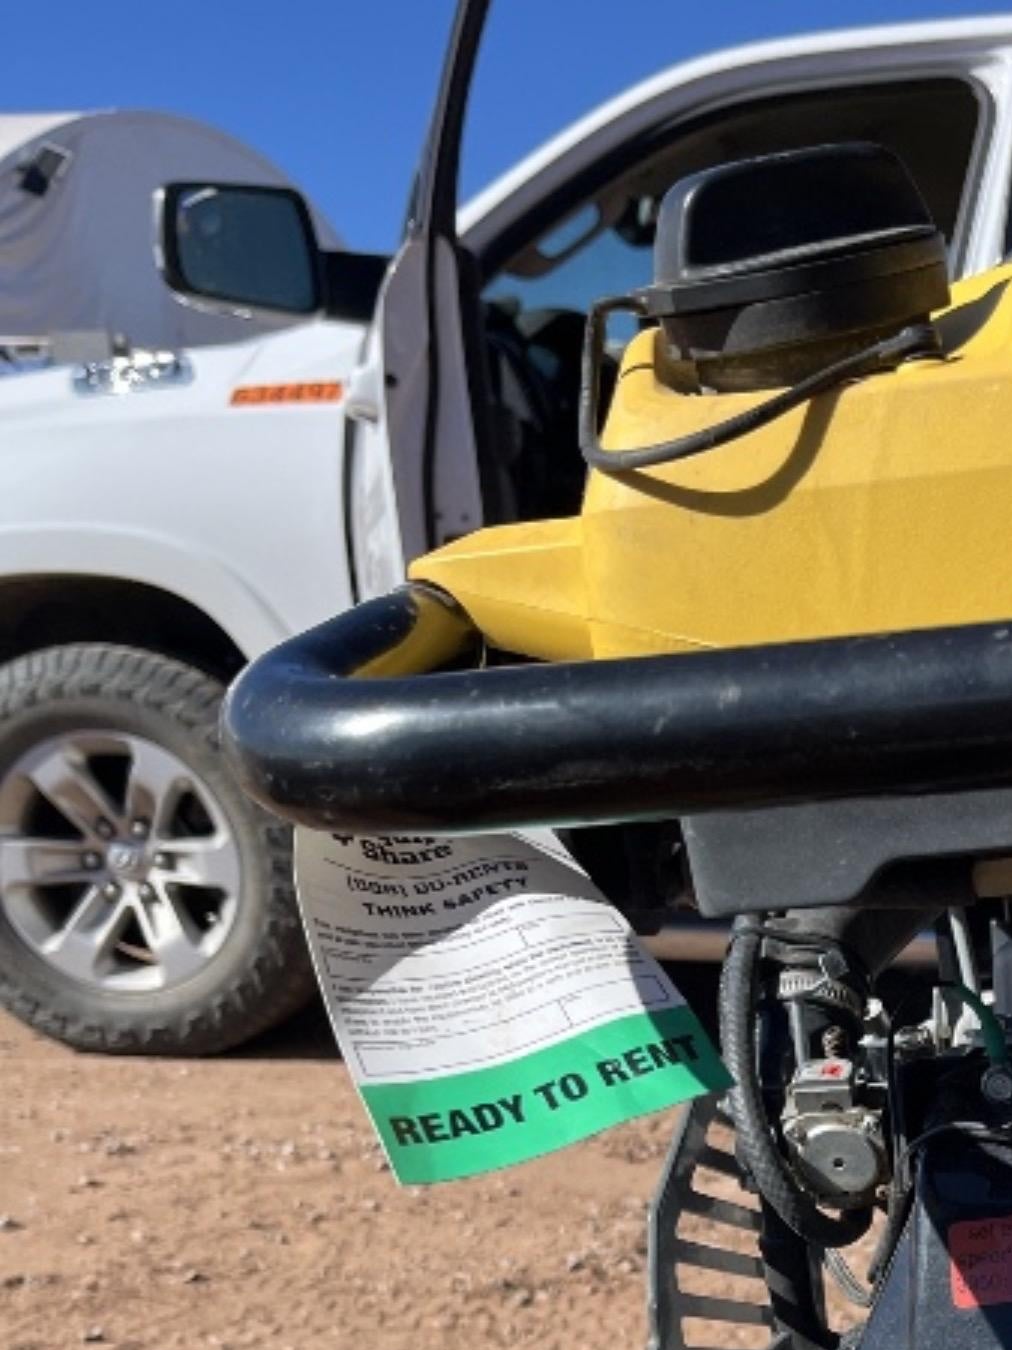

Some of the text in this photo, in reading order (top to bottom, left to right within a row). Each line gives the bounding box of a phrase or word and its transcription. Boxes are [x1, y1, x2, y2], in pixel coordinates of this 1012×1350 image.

[362, 844, 453, 865] Share
[362, 902, 436, 919] THINK
[388, 1034, 700, 1147] READY TO RENT
